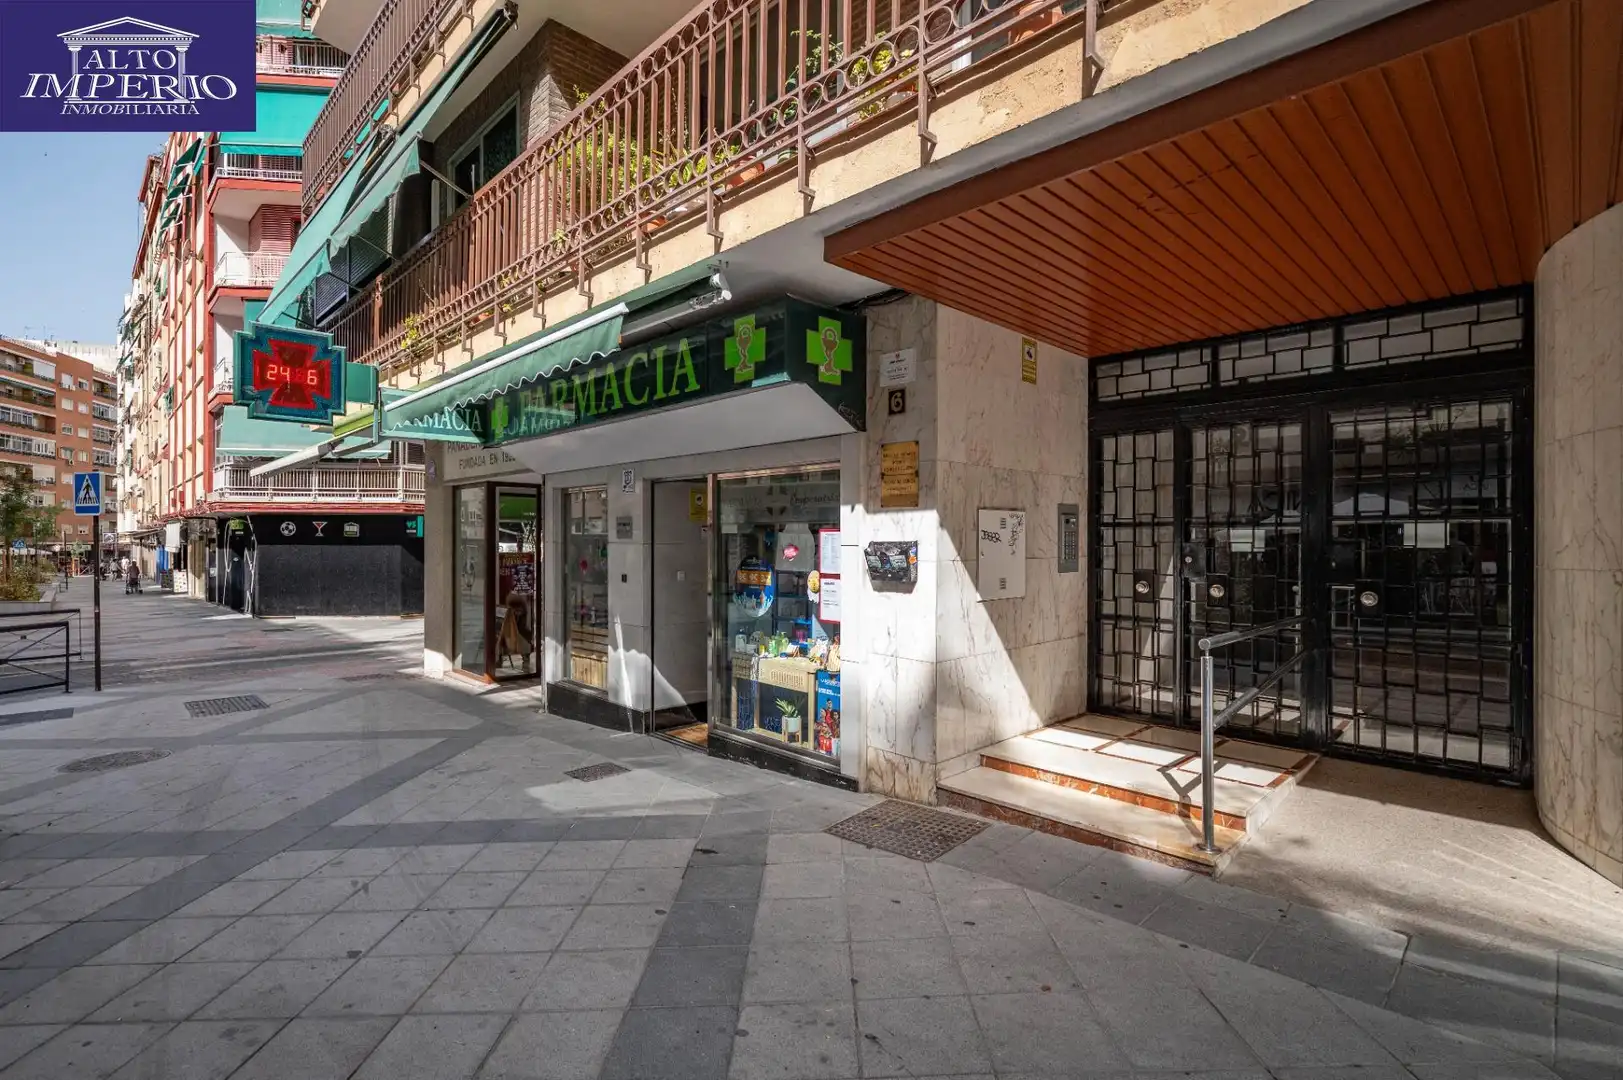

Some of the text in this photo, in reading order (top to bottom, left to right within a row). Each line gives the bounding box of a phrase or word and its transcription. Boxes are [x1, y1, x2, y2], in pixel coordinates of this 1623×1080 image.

[266, 364, 290, 384] 24
[519, 337, 701, 430] FARMACIA
[891, 392, 904, 412] 6
[489, 452, 498, 465] EN
